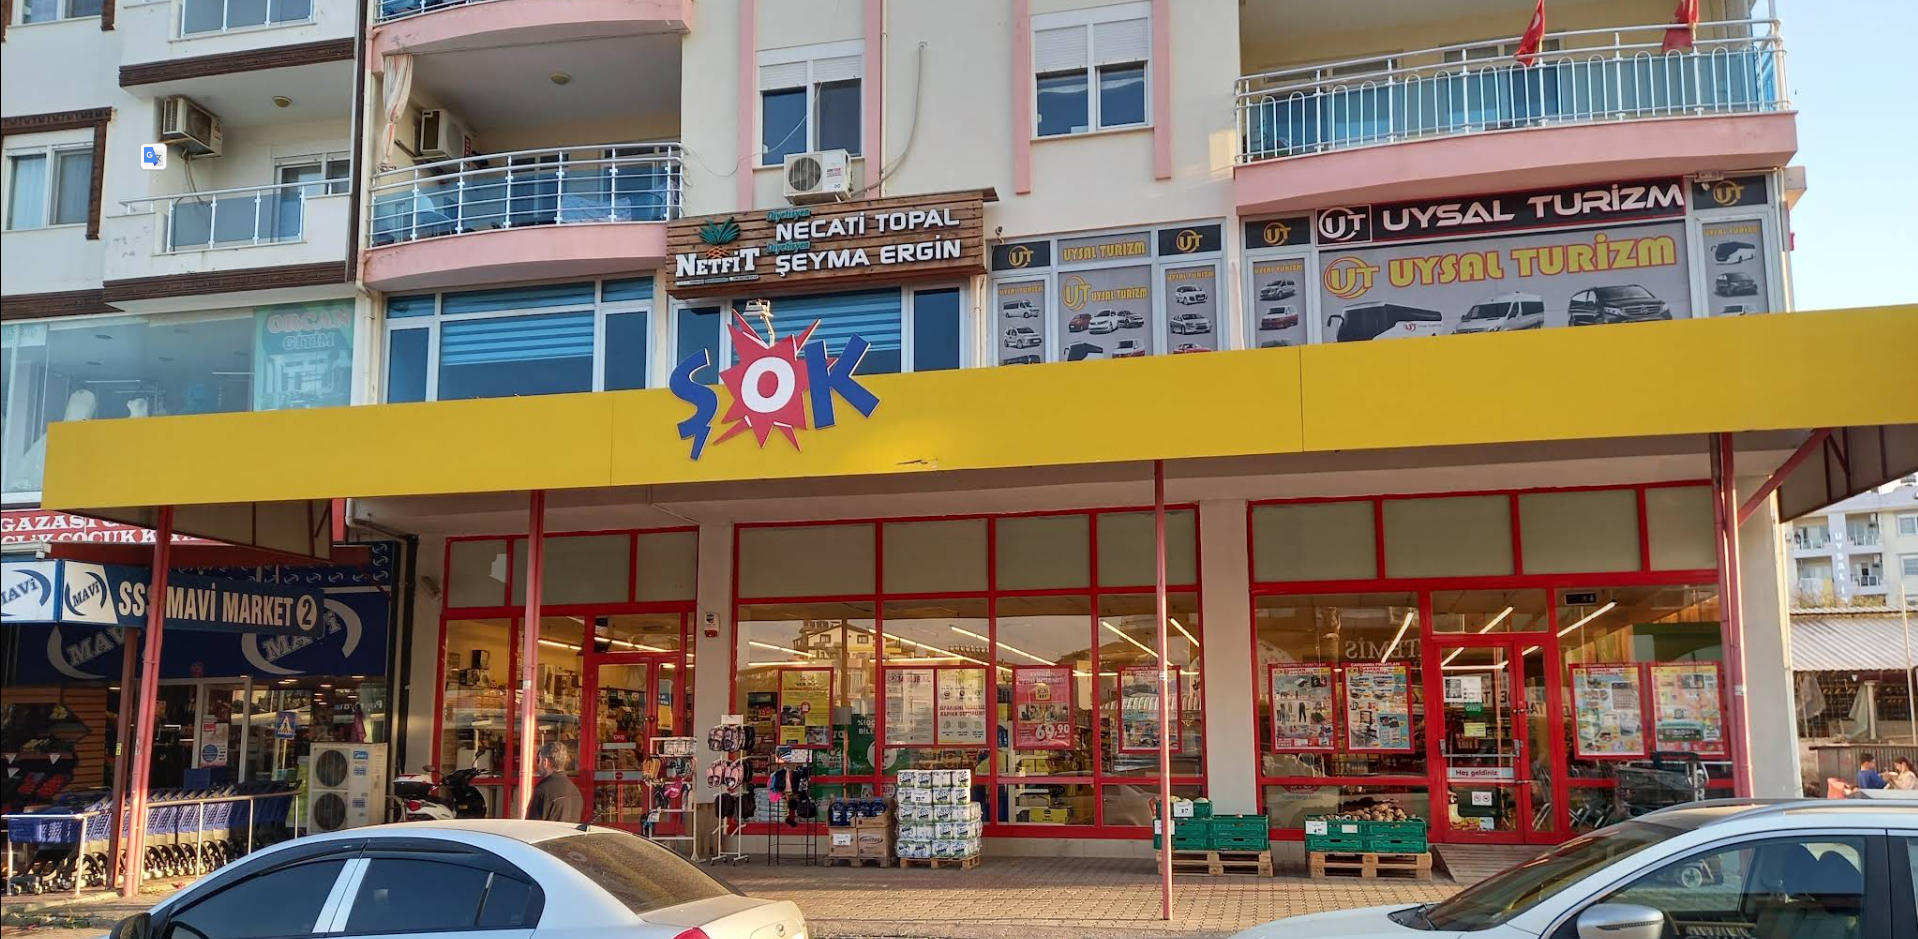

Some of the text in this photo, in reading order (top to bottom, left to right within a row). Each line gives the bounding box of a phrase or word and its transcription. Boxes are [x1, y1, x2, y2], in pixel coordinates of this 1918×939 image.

[776, 208, 960, 241] NECATİ TOPAL
[1319, 207, 1366, 241] UT
[1382, 184, 1685, 232] UYSAL TURİZM
[776, 235, 961, 277] ŞEYMA ERGİN
[1063, 239, 1147, 262] UYSAL TURİZM
[1388, 232, 1677, 288] UYSAL TURİZM
[1062, 275, 1092, 312] UT
[1323, 257, 1380, 299] UT
[1091, 290, 1115, 302] UYSAL
[267, 308, 351, 334] ORCAN
[282, 331, 335, 351] GİYİM
[669, 334, 880, 461] ŞOK
[118, 580, 314, 627] SS MAVİ MARKET 2
[1470, 769, 1498, 778] geldiniz
